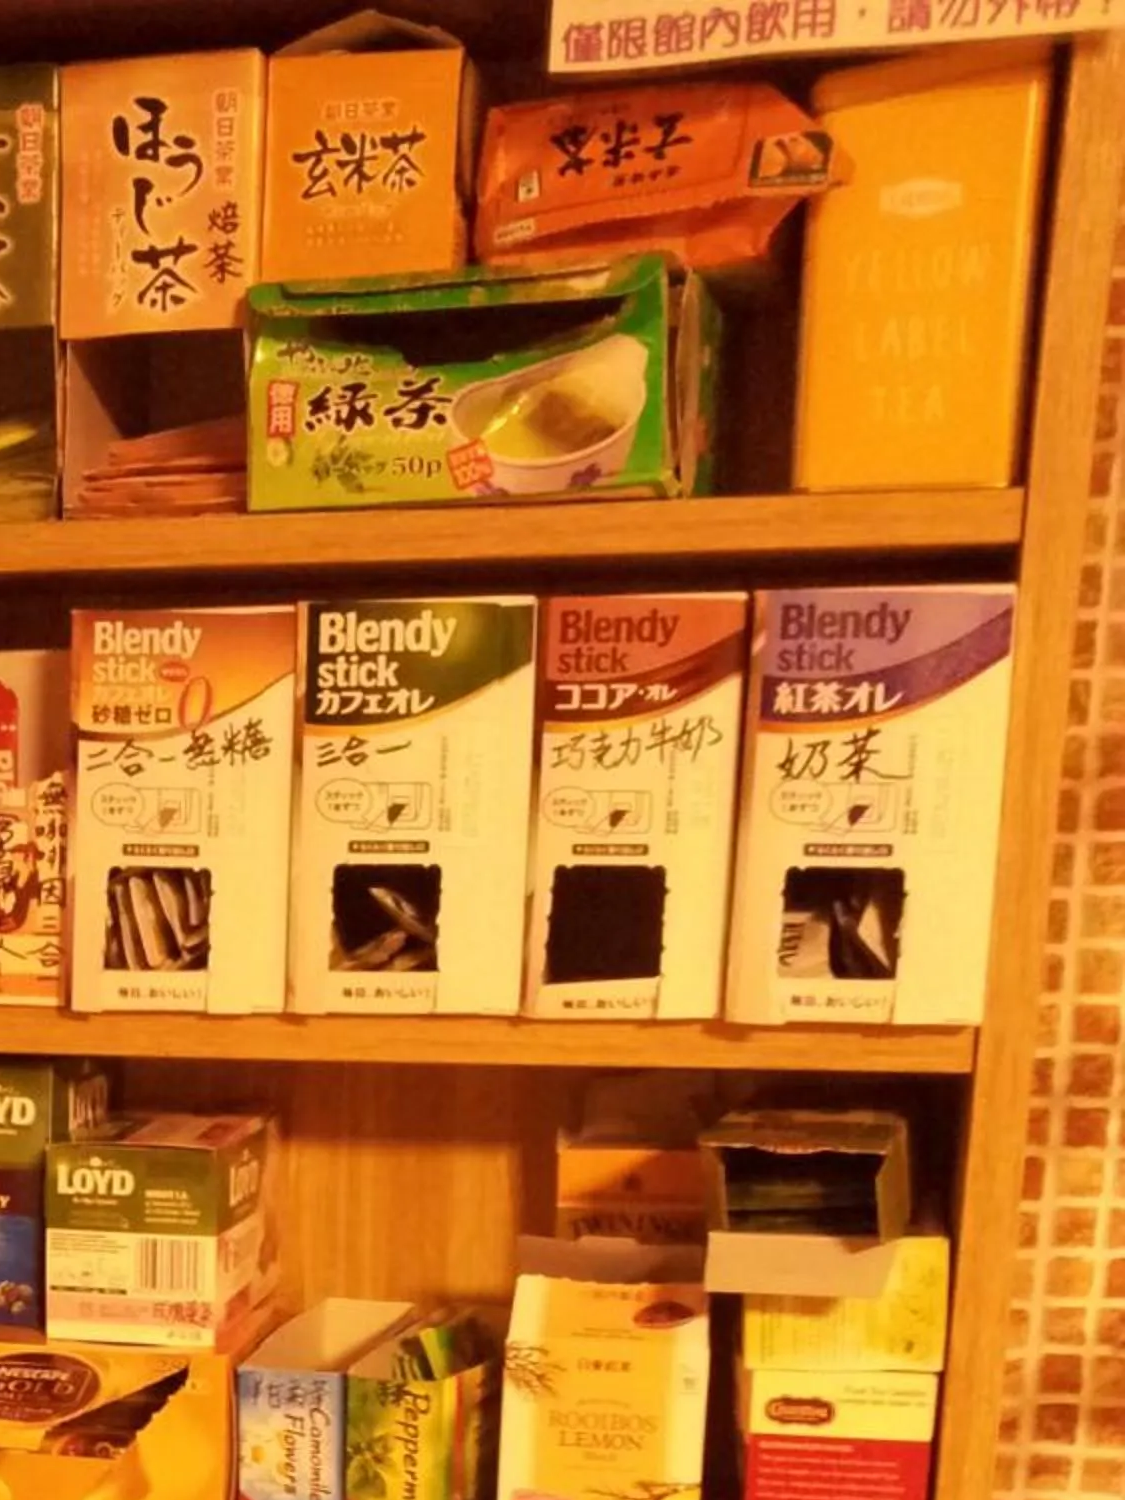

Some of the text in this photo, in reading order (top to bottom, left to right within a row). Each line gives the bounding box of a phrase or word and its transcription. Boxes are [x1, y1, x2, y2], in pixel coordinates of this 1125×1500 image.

[292, 125, 427, 200] 玄米茶
[111, 96, 205, 314] ほうじ茶
[854, 315, 968, 363] LABEL
[304, 376, 453, 433] 緑茶
[870, 384, 945, 421] TEA
[93, 620, 203, 659] Blendy
[318, 609, 458, 658] Blendy
[559, 608, 681, 648] Blendy
[779, 602, 913, 644] Blendy
[92, 659, 157, 684] stick
[317, 654, 401, 690] stick
[556, 647, 630, 676] stick
[777, 643, 857, 673] stick
[315, 688, 436, 716] カフェオレ
[773, 681, 905, 715] 紅茶オレ
[551, 714, 724, 771] 巧克力牛奶
[776, 727, 911, 783] 奶茶
[56, 1163, 136, 1197] LOYD
[548, 1409, 658, 1434] ROOIBOS
[558, 1430, 647, 1451] LEMON
[283, 1412, 305, 1497] Flowers
